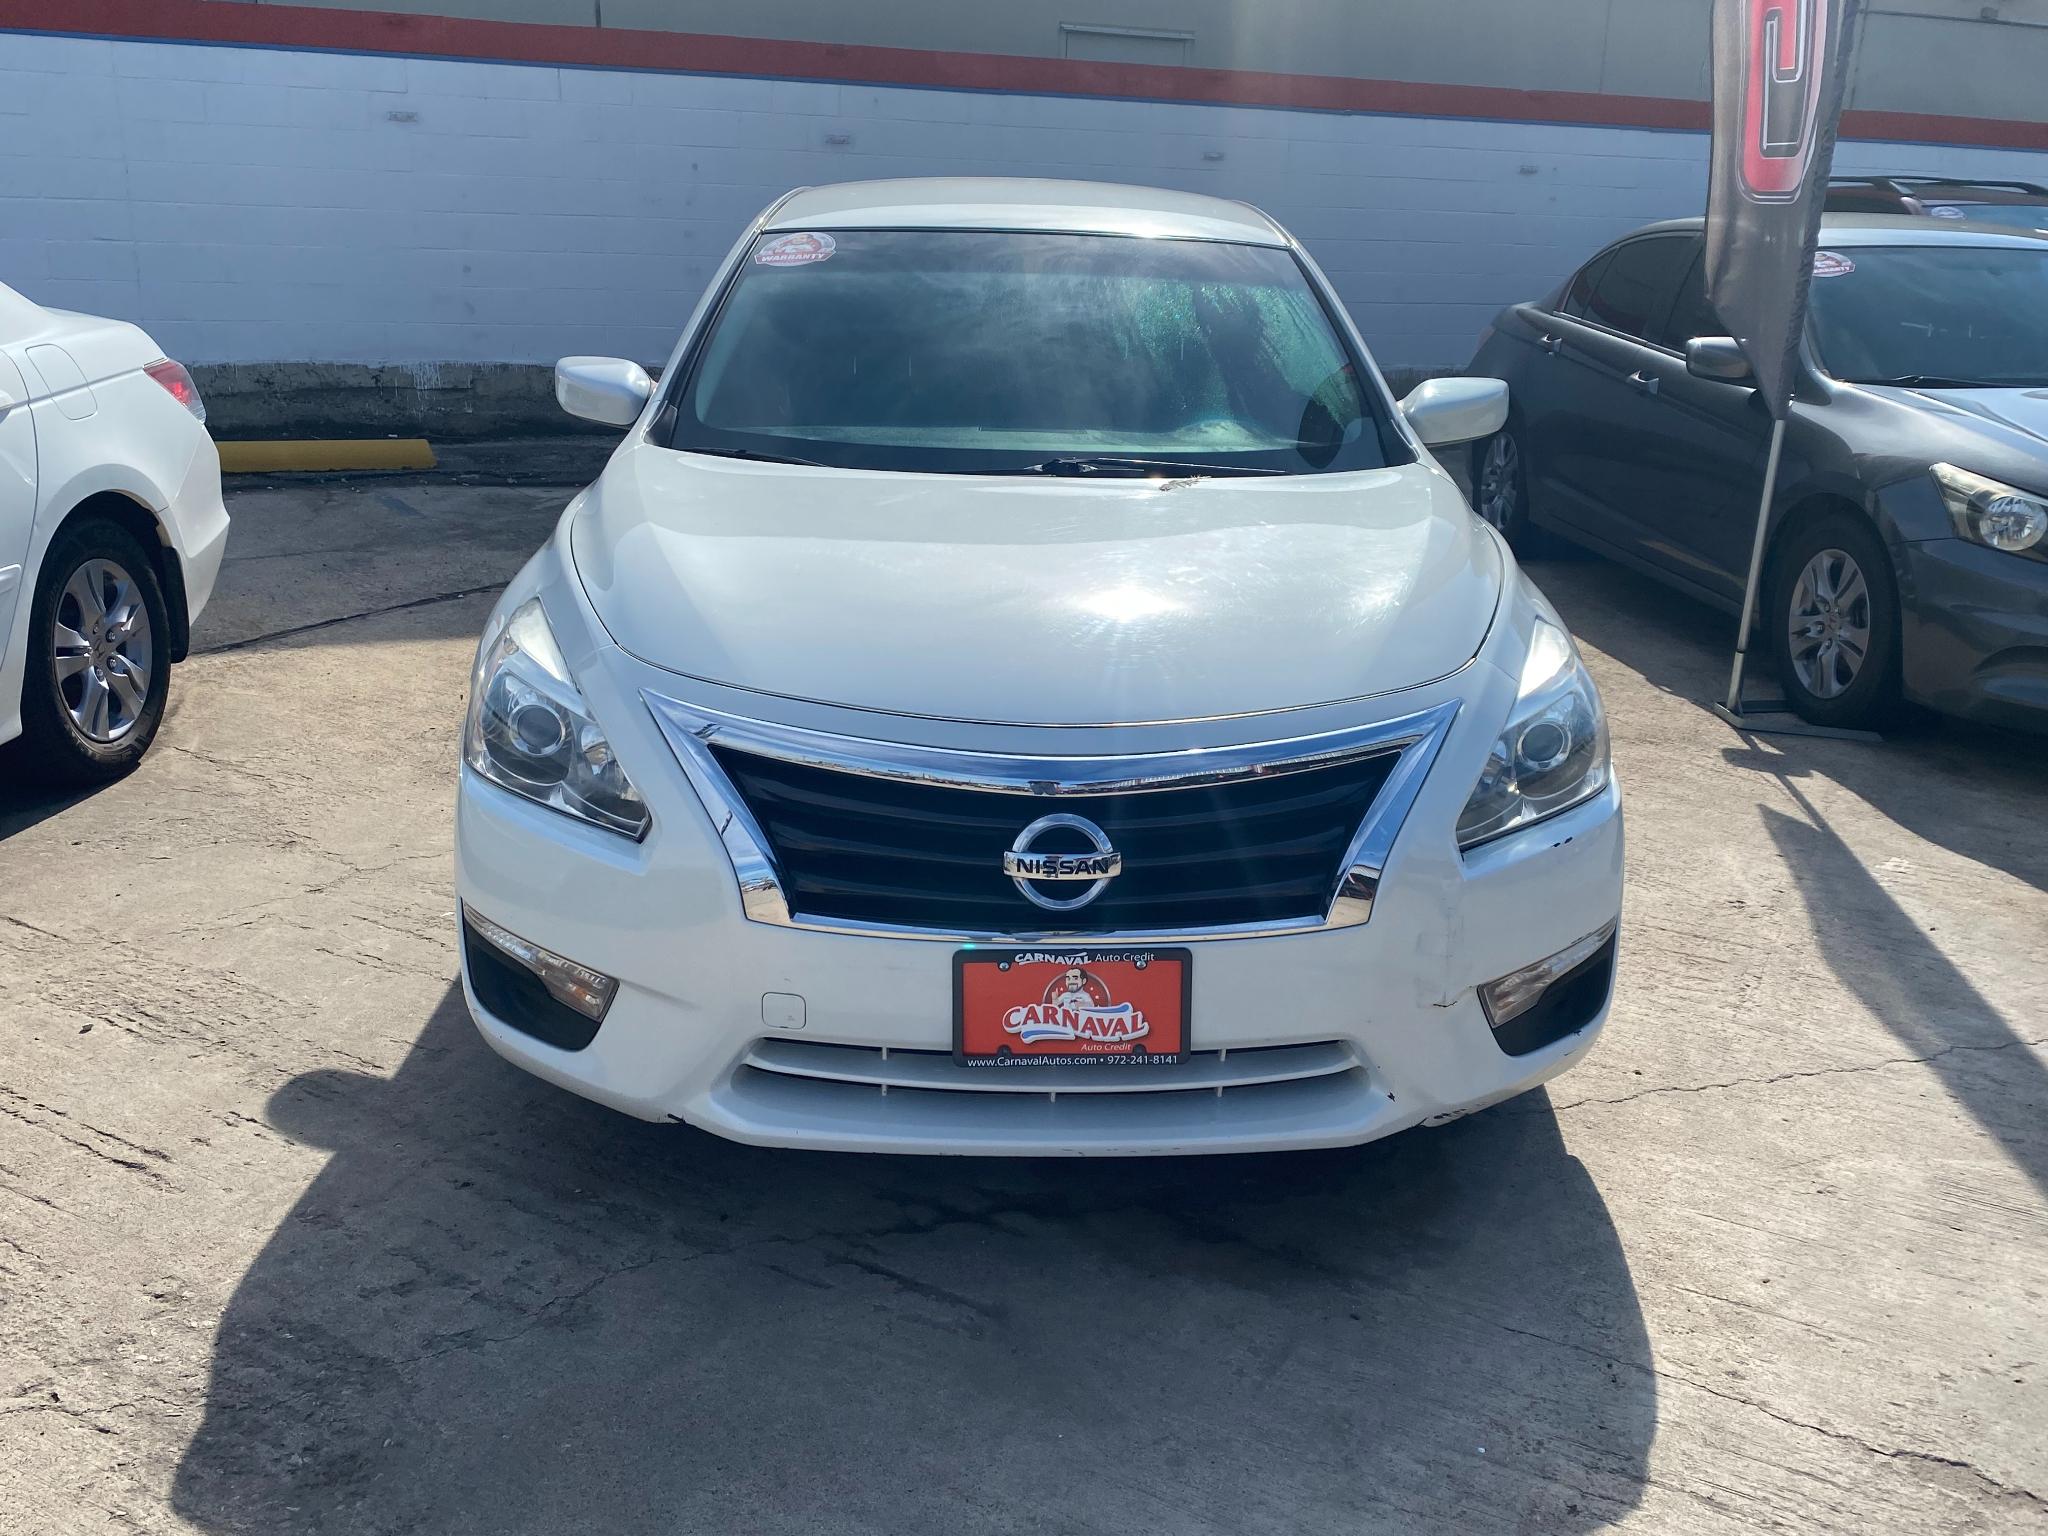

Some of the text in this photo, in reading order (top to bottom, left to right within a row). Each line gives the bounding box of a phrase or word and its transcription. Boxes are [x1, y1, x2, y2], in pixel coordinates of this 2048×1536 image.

[761, 253, 825, 262] WARRANTY
[1016, 858, 1110, 875] NISSAN
[1014, 952, 1155, 965] CARNAVAL Auto Credit
[1003, 1005, 1147, 1039] CARNAVAL
[1081, 1043, 1131, 1051] Auto Credit
[967, 1055, 1178, 1067] www.CarnavalAutos.com 972-241-8141
